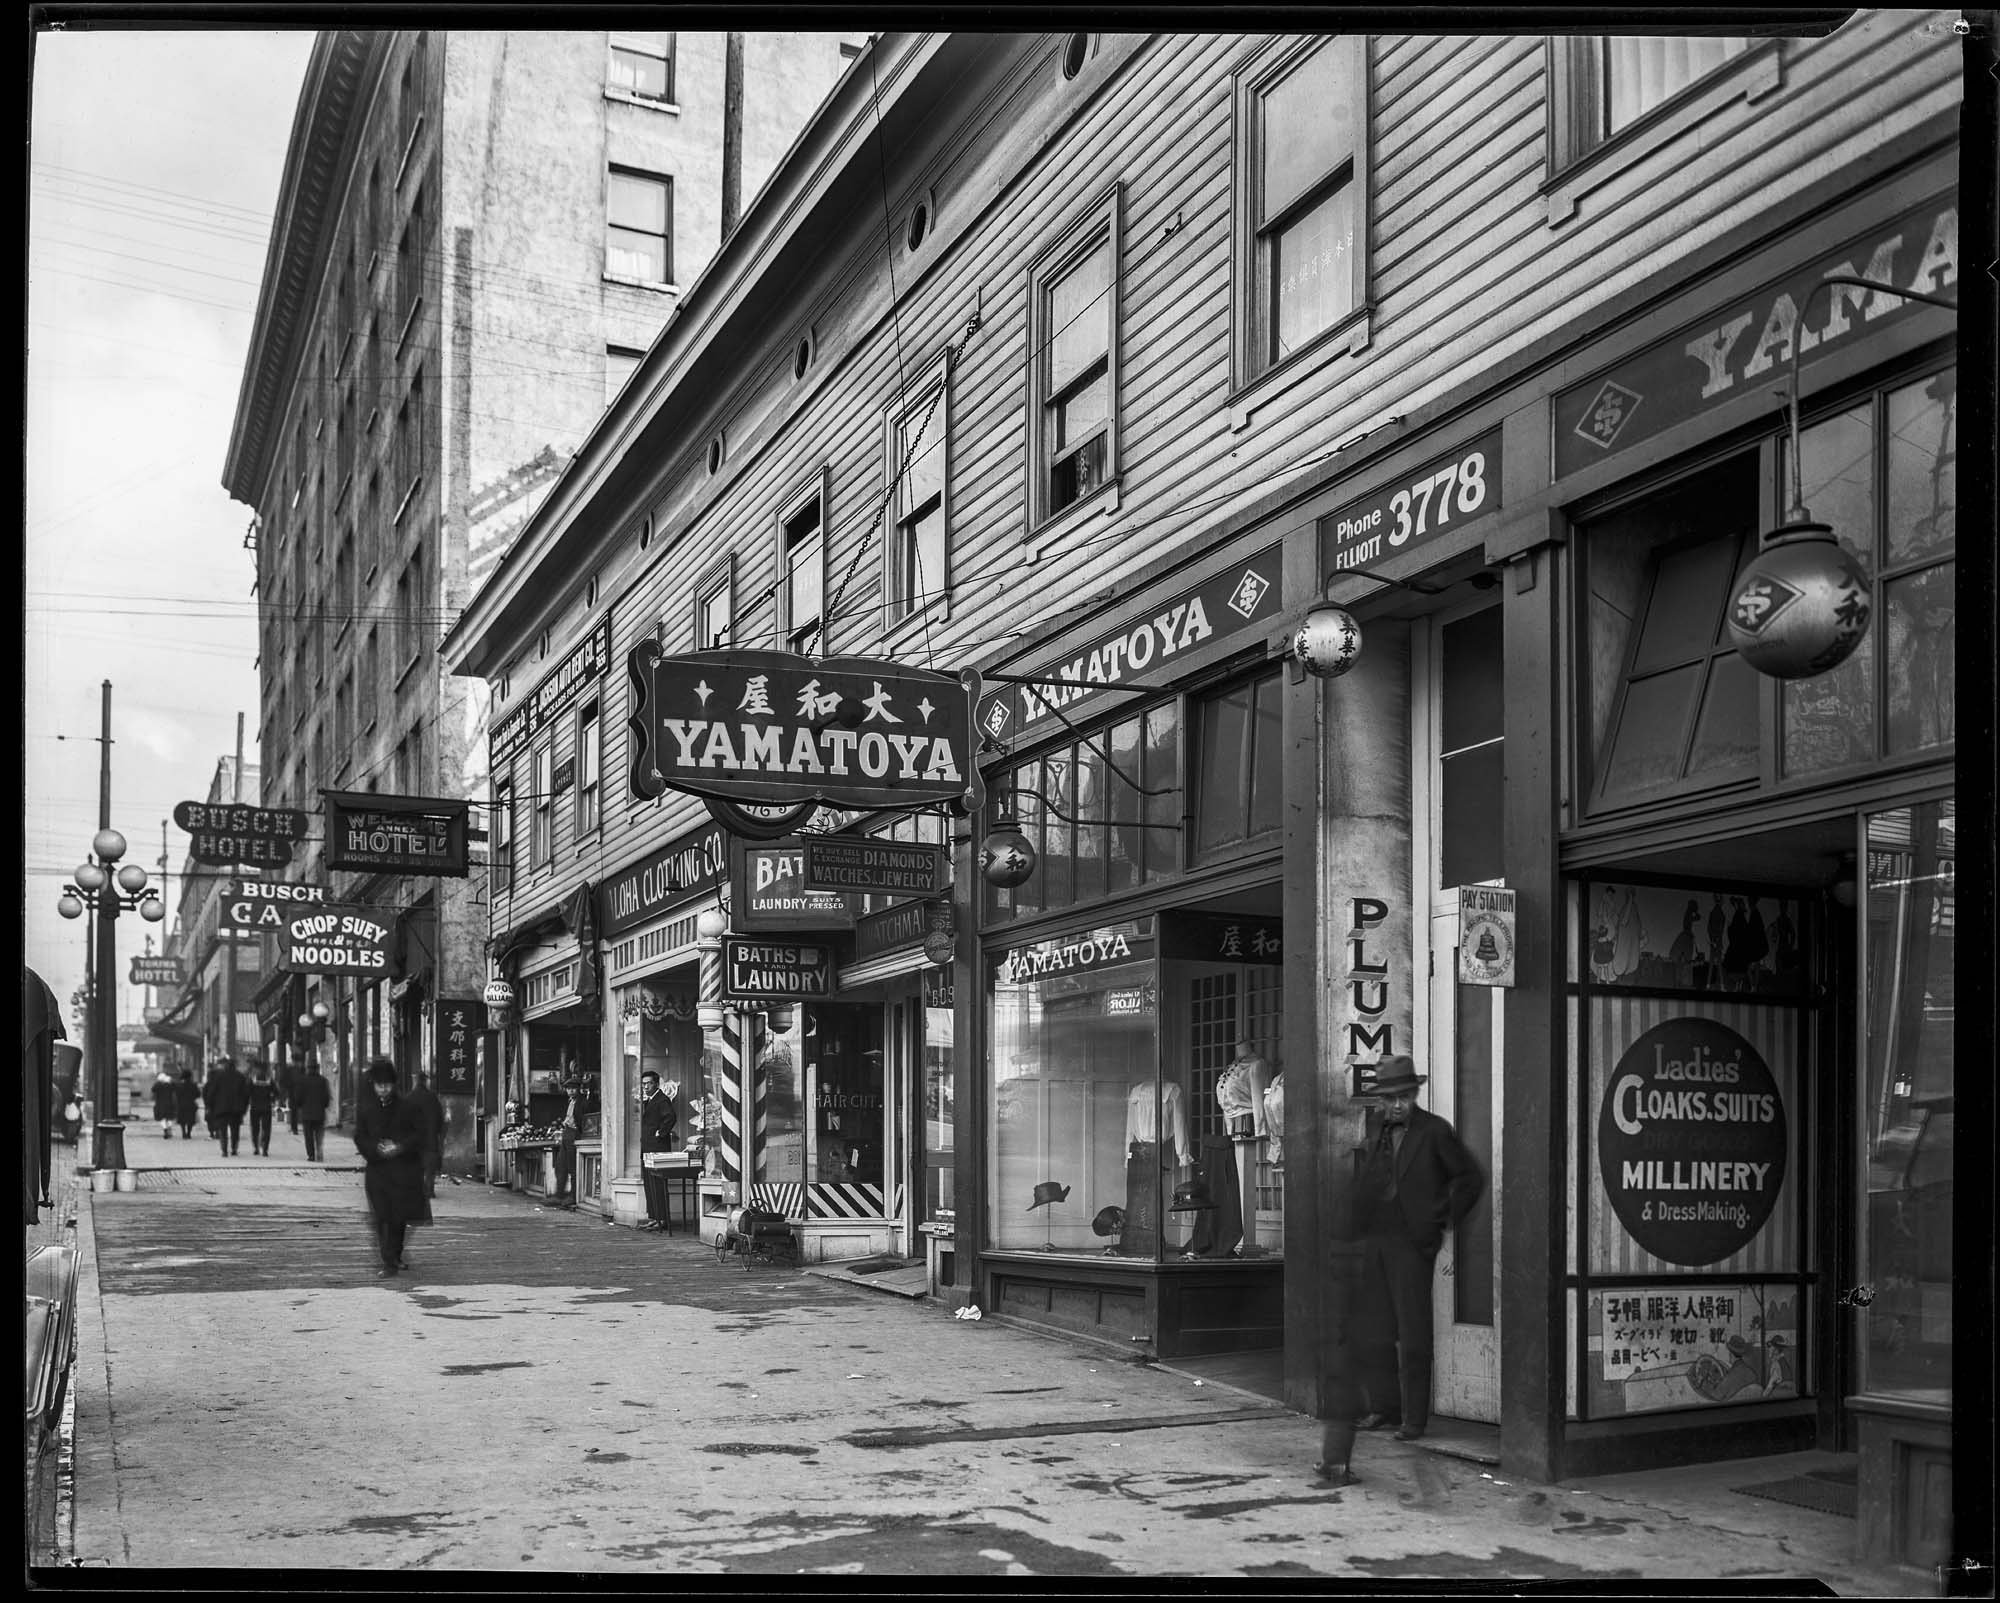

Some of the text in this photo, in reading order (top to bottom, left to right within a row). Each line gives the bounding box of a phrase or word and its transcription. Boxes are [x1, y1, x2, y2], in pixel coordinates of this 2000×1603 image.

[1388, 452, 1486, 546] 3778
[1337, 509, 1382, 544] Phone
[1020, 596, 1213, 723] YAMATOYA
[663, 718, 962, 782] YAMATOYA
[187, 806, 294, 835] BUSCH
[375, 824, 417, 833] ANNEX
[199, 835, 284, 861] HOTEL
[348, 830, 447, 856] HOTEL
[704, 831, 725, 877] CO.
[864, 850, 933, 870] DIAMONDS
[813, 865, 872, 885] WATCHES
[880, 870, 933, 889] JEWELRY
[242, 882, 324, 901] BUSCH
[1462, 889, 1514, 912] PAY STATION
[752, 897, 808, 910] LAUNDRY
[808, 902, 844, 910] PRESSED
[290, 915, 388, 944] CHOP SUEY
[333, 934, 345, 946] &
[291, 946, 385, 967] NOODLES
[737, 946, 797, 964] BATHS
[1008, 934, 1131, 980] YAMATOYA
[135, 969, 180, 982] HOTEL
[734, 963, 827, 992] LAUNDRY
[932, 986, 954, 1006] 609
[814, 1093, 847, 1109] HAIR
[1622, 1160, 1772, 1191] MILLINERY
[1641, 1201, 1653, 1221] &
